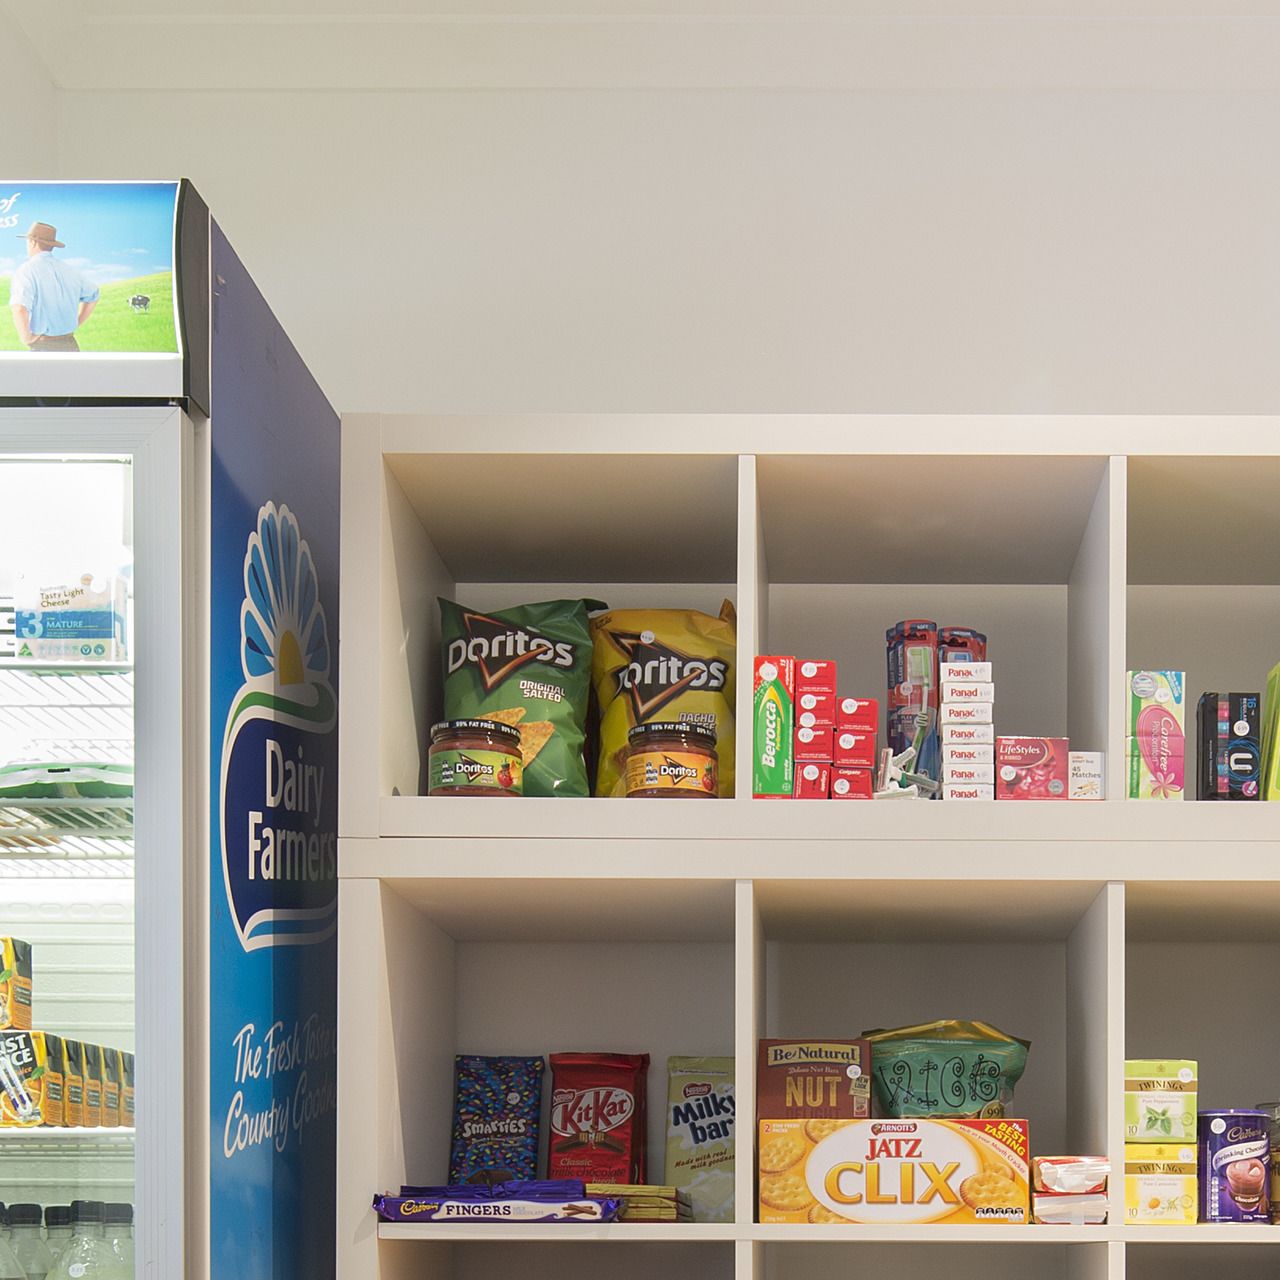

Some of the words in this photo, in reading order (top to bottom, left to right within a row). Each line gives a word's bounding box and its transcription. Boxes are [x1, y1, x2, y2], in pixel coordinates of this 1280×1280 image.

[448, 630, 573, 673] Doritos
[520, 680, 565, 695] ORIGINAL
[523, 690, 561, 703] SALTED
[761, 701, 777, 767] Berocca
[1000, 745, 1040, 755] LifeStyles
[456, 763, 493, 775] Doritos
[263, 737, 326, 824] Dairy
[247, 811, 336, 882] Farmers
[773, 1048, 792, 1060] Be
[796, 1047, 856, 1063] Natural
[785, 1077, 841, 1107] NUT
[1138, 1081, 1184, 1092] TWININGS
[560, 1091, 628, 1132] KitKat
[692, 1121, 730, 1144] bar
[998, 1122, 1026, 1144] BEST
[1012, 1124, 1023, 1132] The
[865, 1138, 922, 1160] JATZ
[984, 1124, 1026, 1157] TASTING
[825, 1161, 960, 1204] CLIX
[447, 1205, 511, 1216] FINGERS
